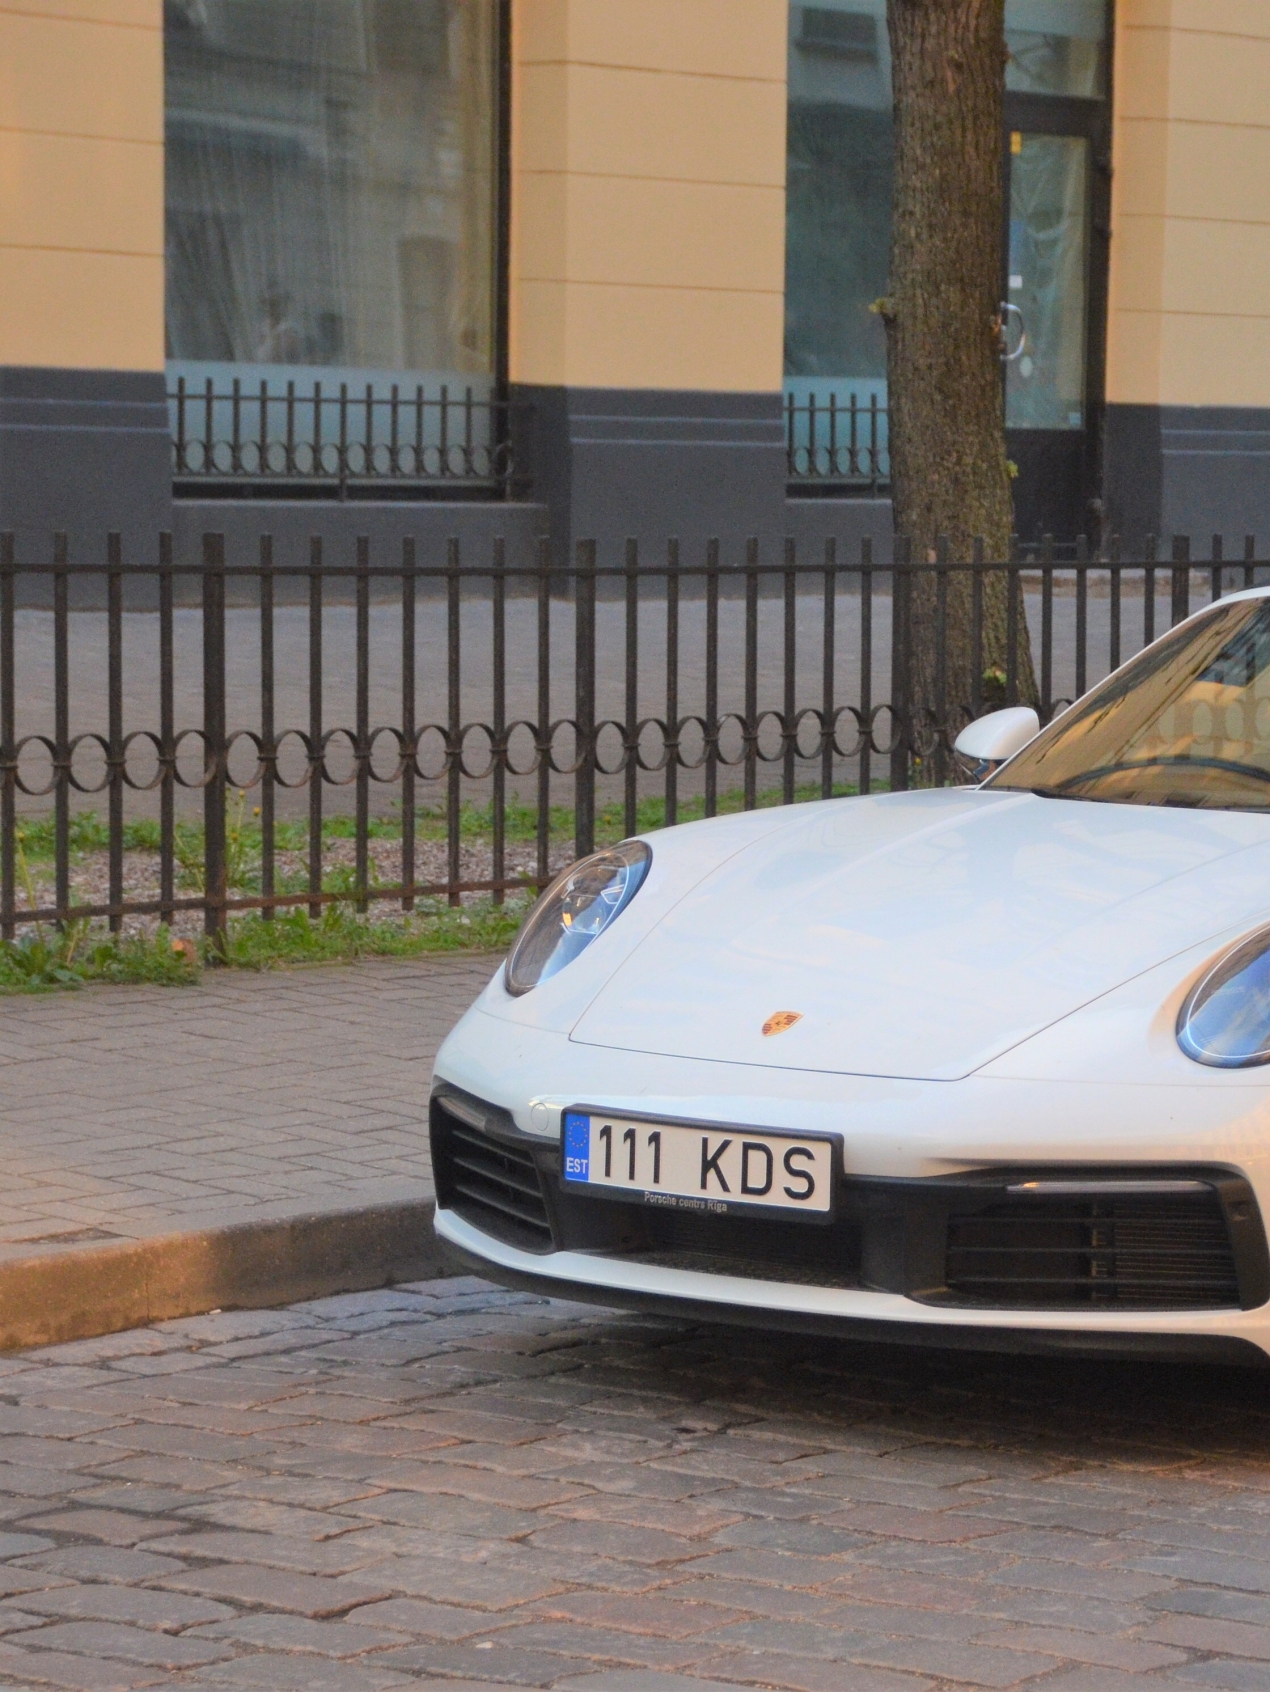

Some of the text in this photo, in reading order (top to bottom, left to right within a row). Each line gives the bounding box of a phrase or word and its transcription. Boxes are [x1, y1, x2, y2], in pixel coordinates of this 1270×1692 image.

[566, 1157, 588, 1175] EST
[599, 1124, 816, 1201] 111 KDS
[644, 1191, 728, 1213] Porsche centrs Rīga
